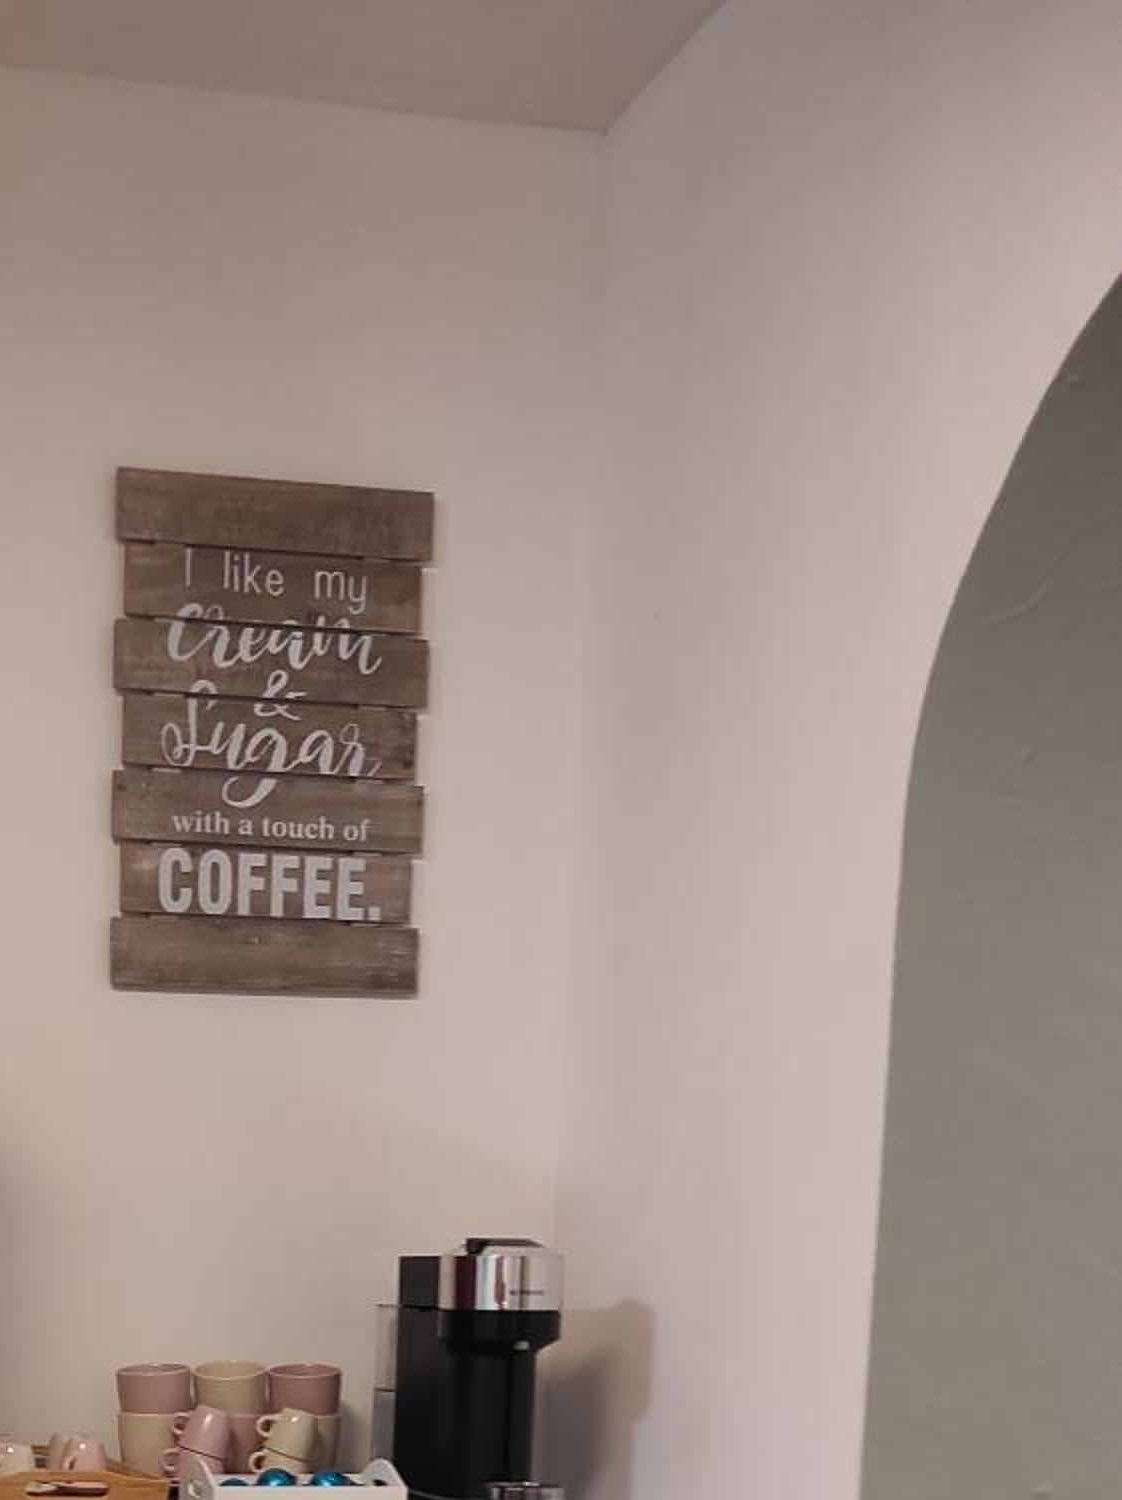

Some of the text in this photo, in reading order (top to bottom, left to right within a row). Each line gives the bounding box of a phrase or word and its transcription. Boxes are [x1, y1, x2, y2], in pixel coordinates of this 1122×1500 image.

[184, 548, 368, 614] I like my
[166, 603, 382, 676] Cream
[253, 669, 307, 720] &
[161, 680, 380, 809] Sugar
[171, 811, 374, 842] with a touch of
[157, 847, 382, 922] COFFEE.
